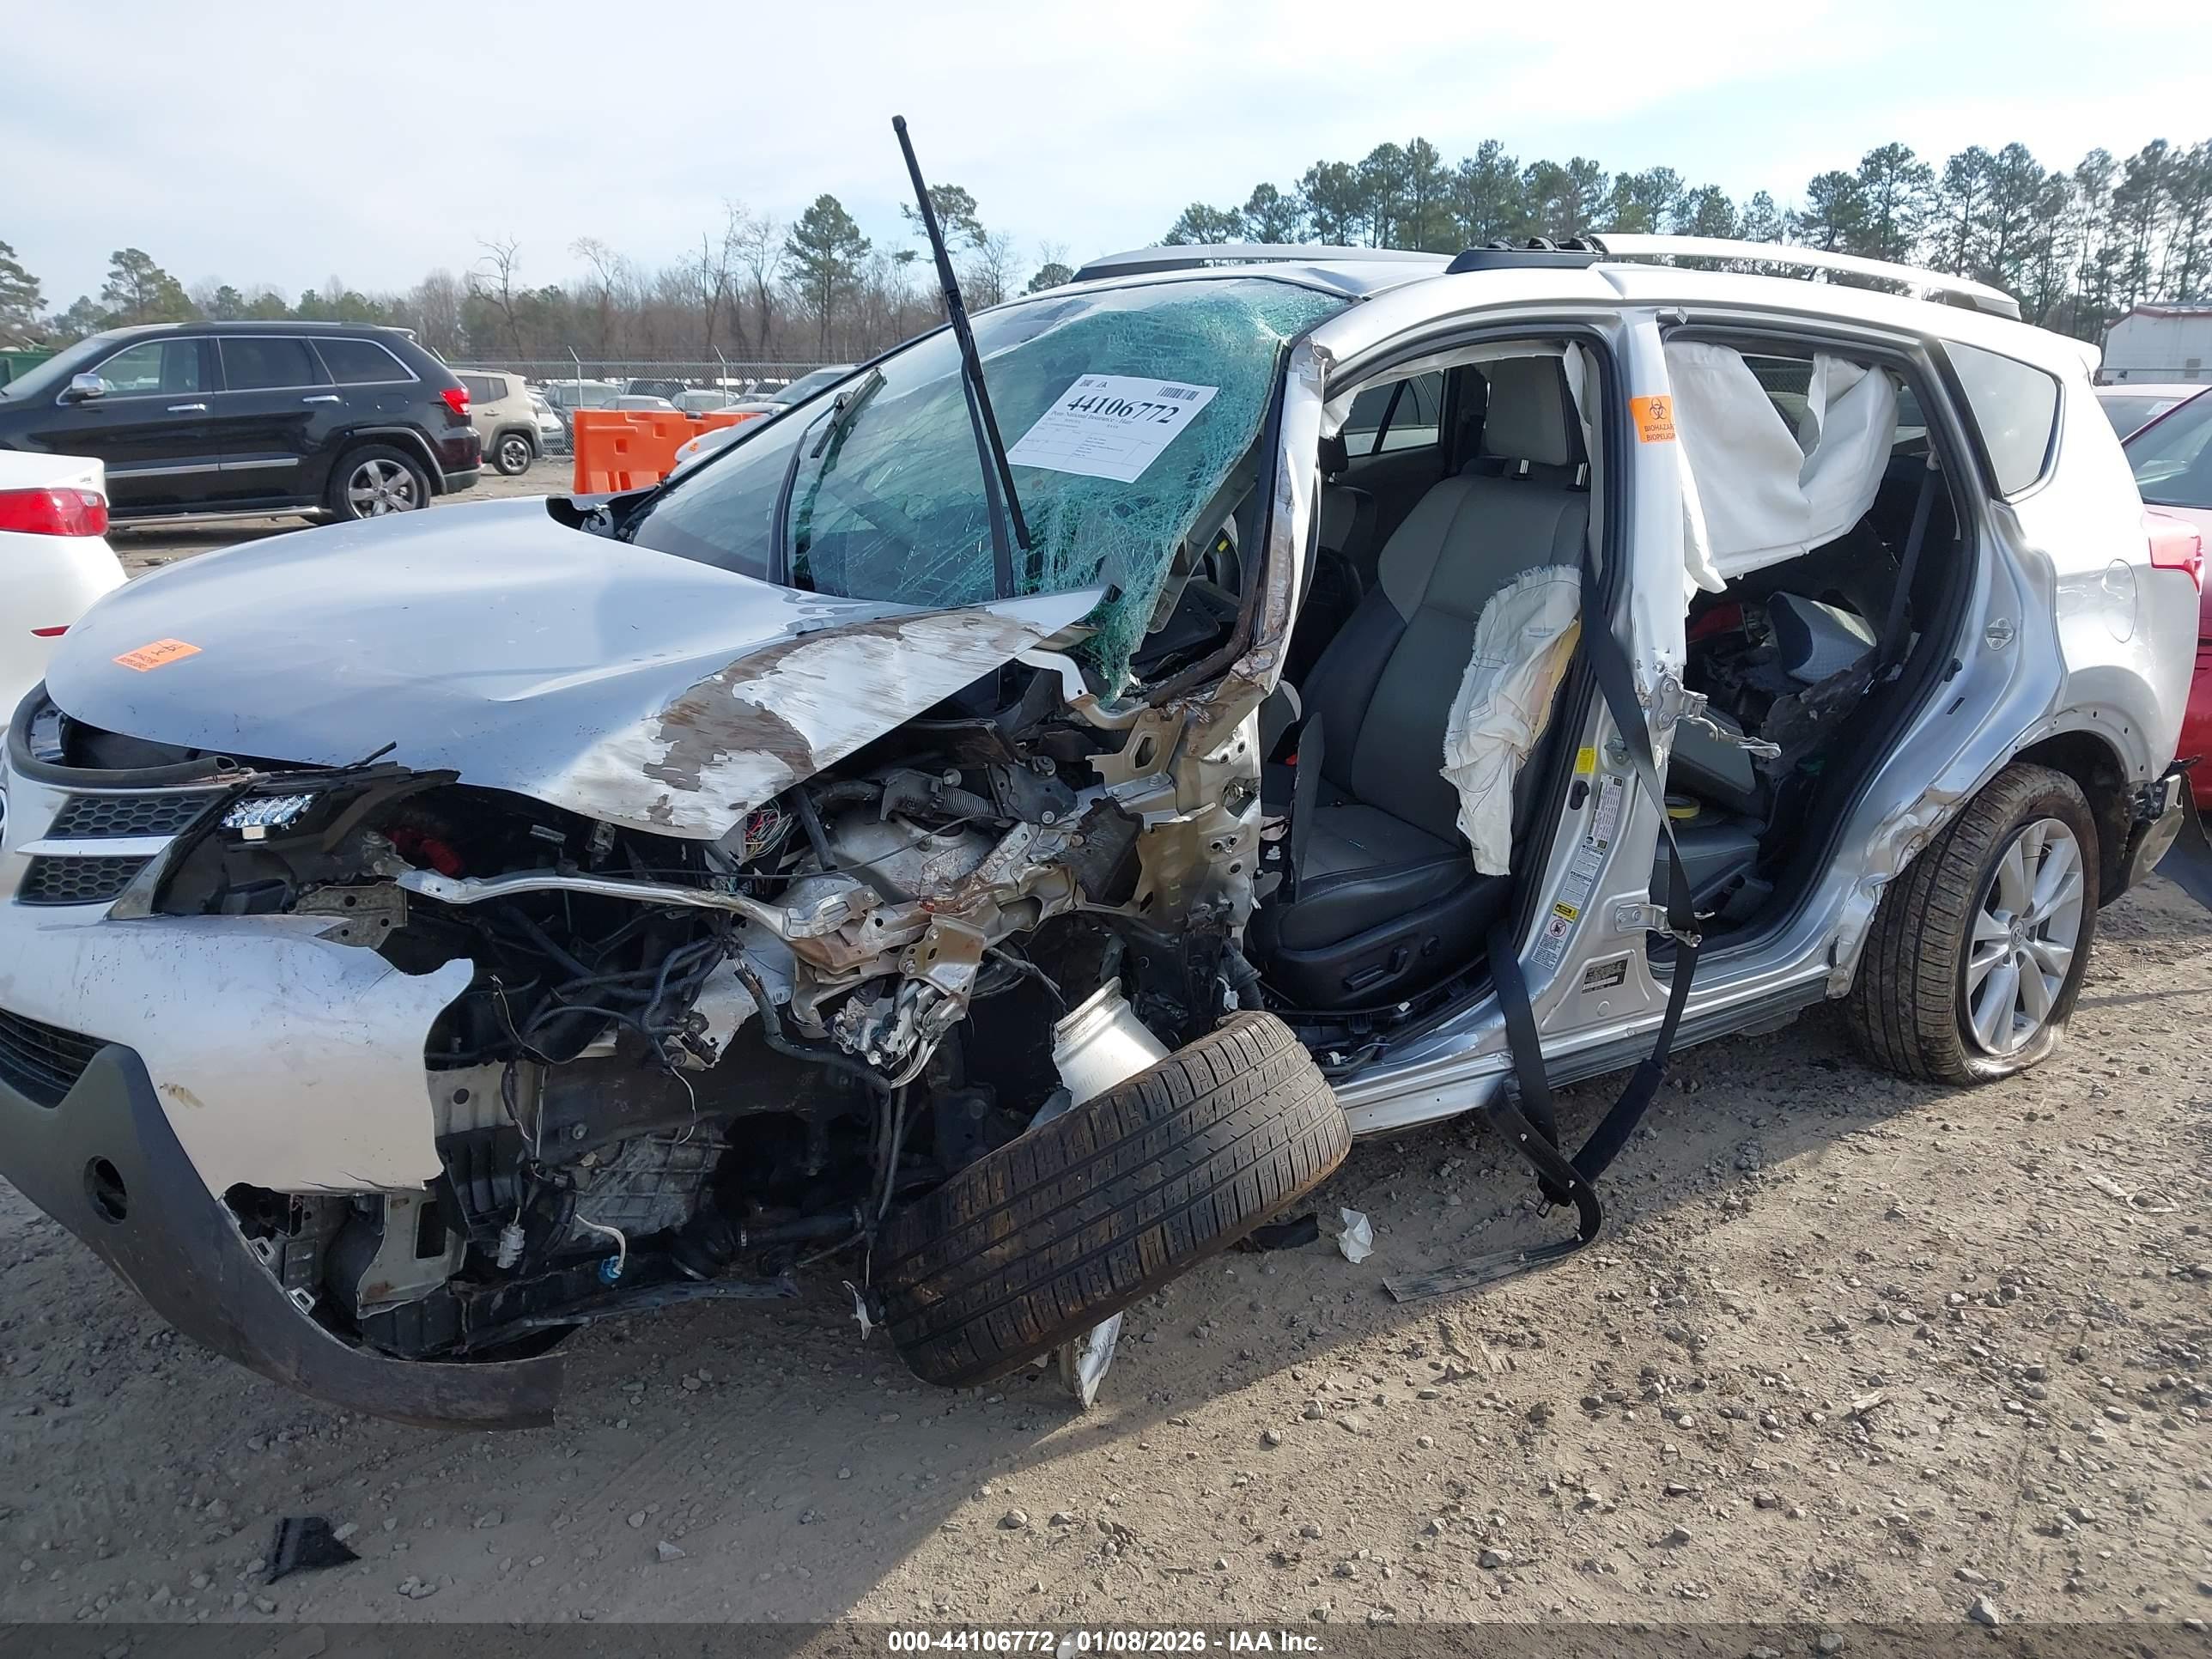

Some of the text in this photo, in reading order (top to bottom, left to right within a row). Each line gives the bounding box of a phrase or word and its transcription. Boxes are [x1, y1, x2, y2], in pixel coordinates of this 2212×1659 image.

[1067, 394, 1180, 423] 44106772
[1644, 423, 1675, 432] BIOHAZAR
[1646, 432, 1676, 441] BIOPELIGR
